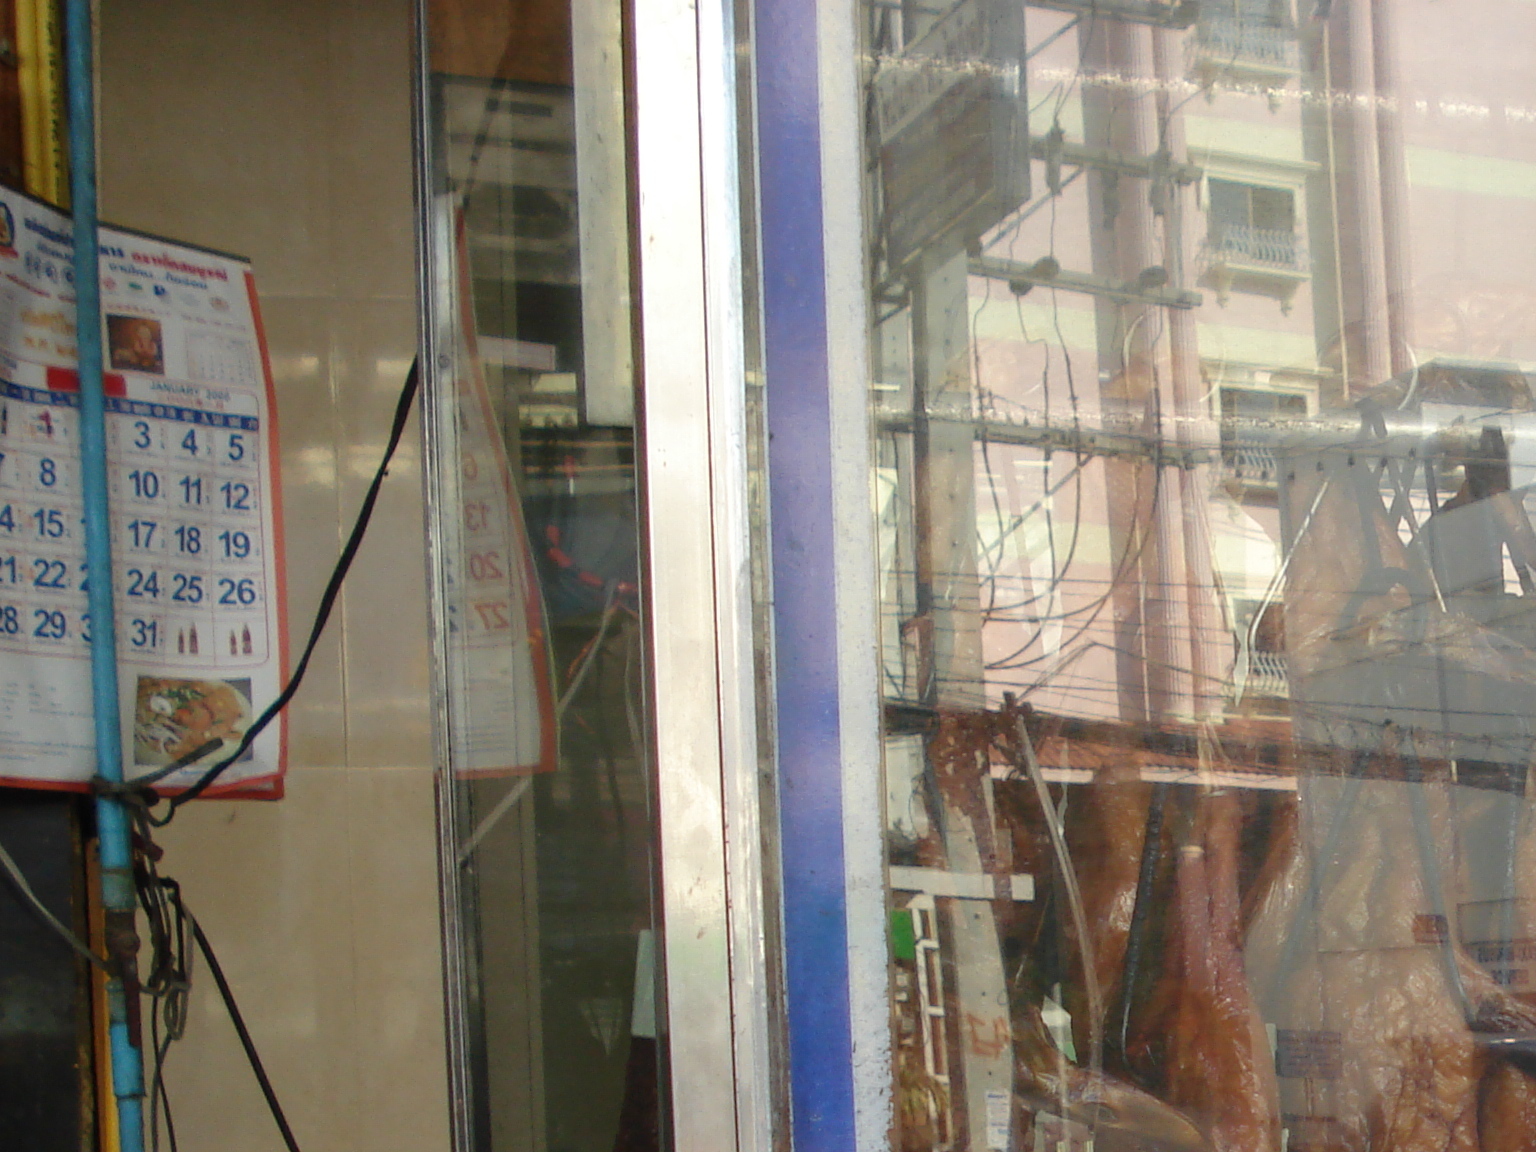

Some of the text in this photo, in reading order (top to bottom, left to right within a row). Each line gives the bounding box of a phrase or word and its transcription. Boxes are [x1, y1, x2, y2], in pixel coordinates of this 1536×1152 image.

[134, 421, 151, 449] 3
[182, 428, 198, 455] 4
[228, 434, 244, 461] 5
[39, 458, 250, 510] 8 10 11 12
[0, 504, 250, 558] 4 15 17 18 19
[33, 558, 66, 588] 22
[127, 569, 160, 598] 24
[172, 573, 203, 603] 25
[218, 578, 256, 605] 26
[33, 609, 66, 639] 29
[131, 619, 157, 648] 31
